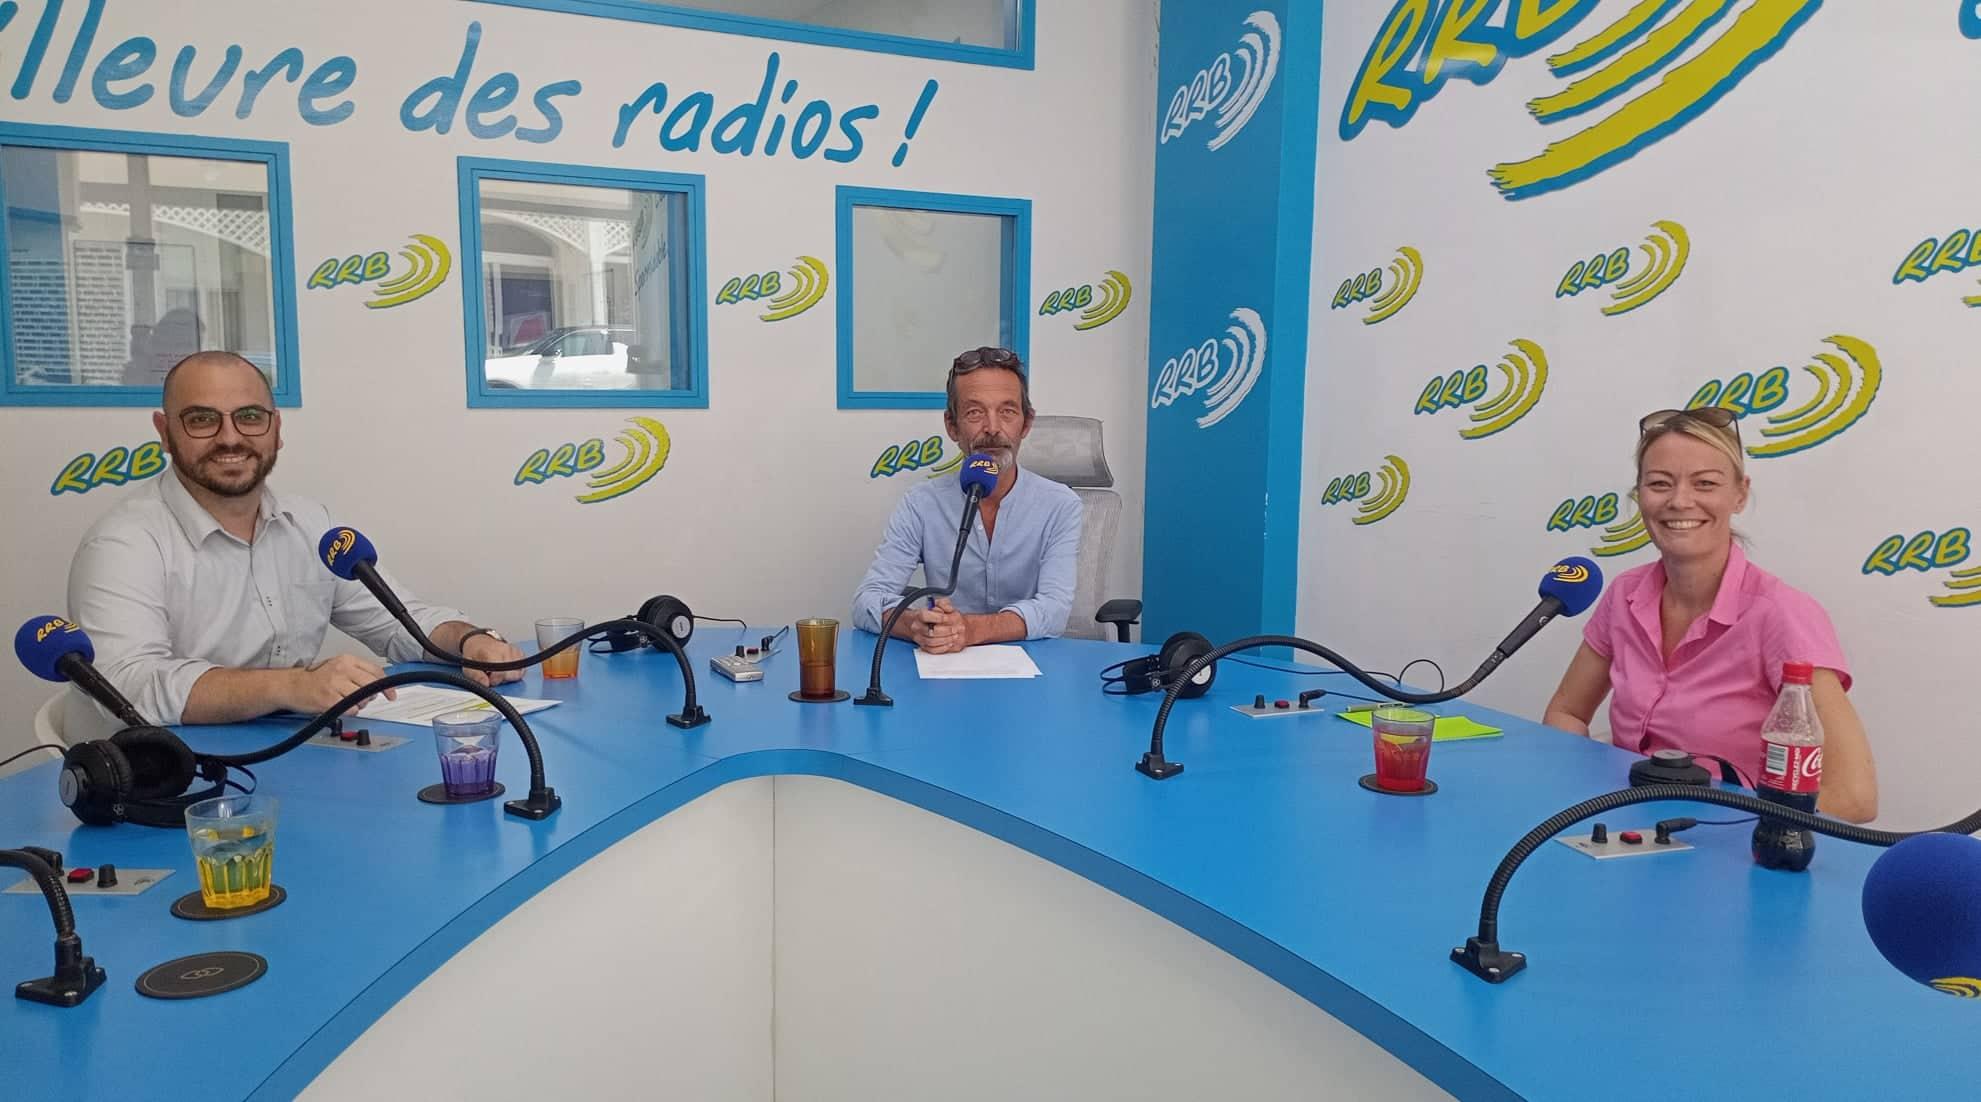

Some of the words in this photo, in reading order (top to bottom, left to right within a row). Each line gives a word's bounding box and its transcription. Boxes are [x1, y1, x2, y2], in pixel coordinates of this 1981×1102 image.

[0, 0, 357, 126] lleure
[400, 21, 582, 144] des
[612, 51, 879, 163] radios
[1161, 53, 1231, 144] RRB
[307, 252, 390, 289] RRB
[715, 271, 780, 305] RRB
[1331, 268, 1382, 310] RRB
[1556, 247, 1629, 298] RRB
[1039, 285, 1092, 316] RRB
[1152, 338, 1218, 408] RRB
[1415, 365, 1487, 415] RRB
[50, 441, 167, 496] RRB
[514, 438, 605, 486] RRB
[870, 435, 943, 478] RRB
[1321, 471, 1370, 504] RRB
[1547, 492, 1618, 532] RRB
[1862, 527, 1970, 576] RRB
